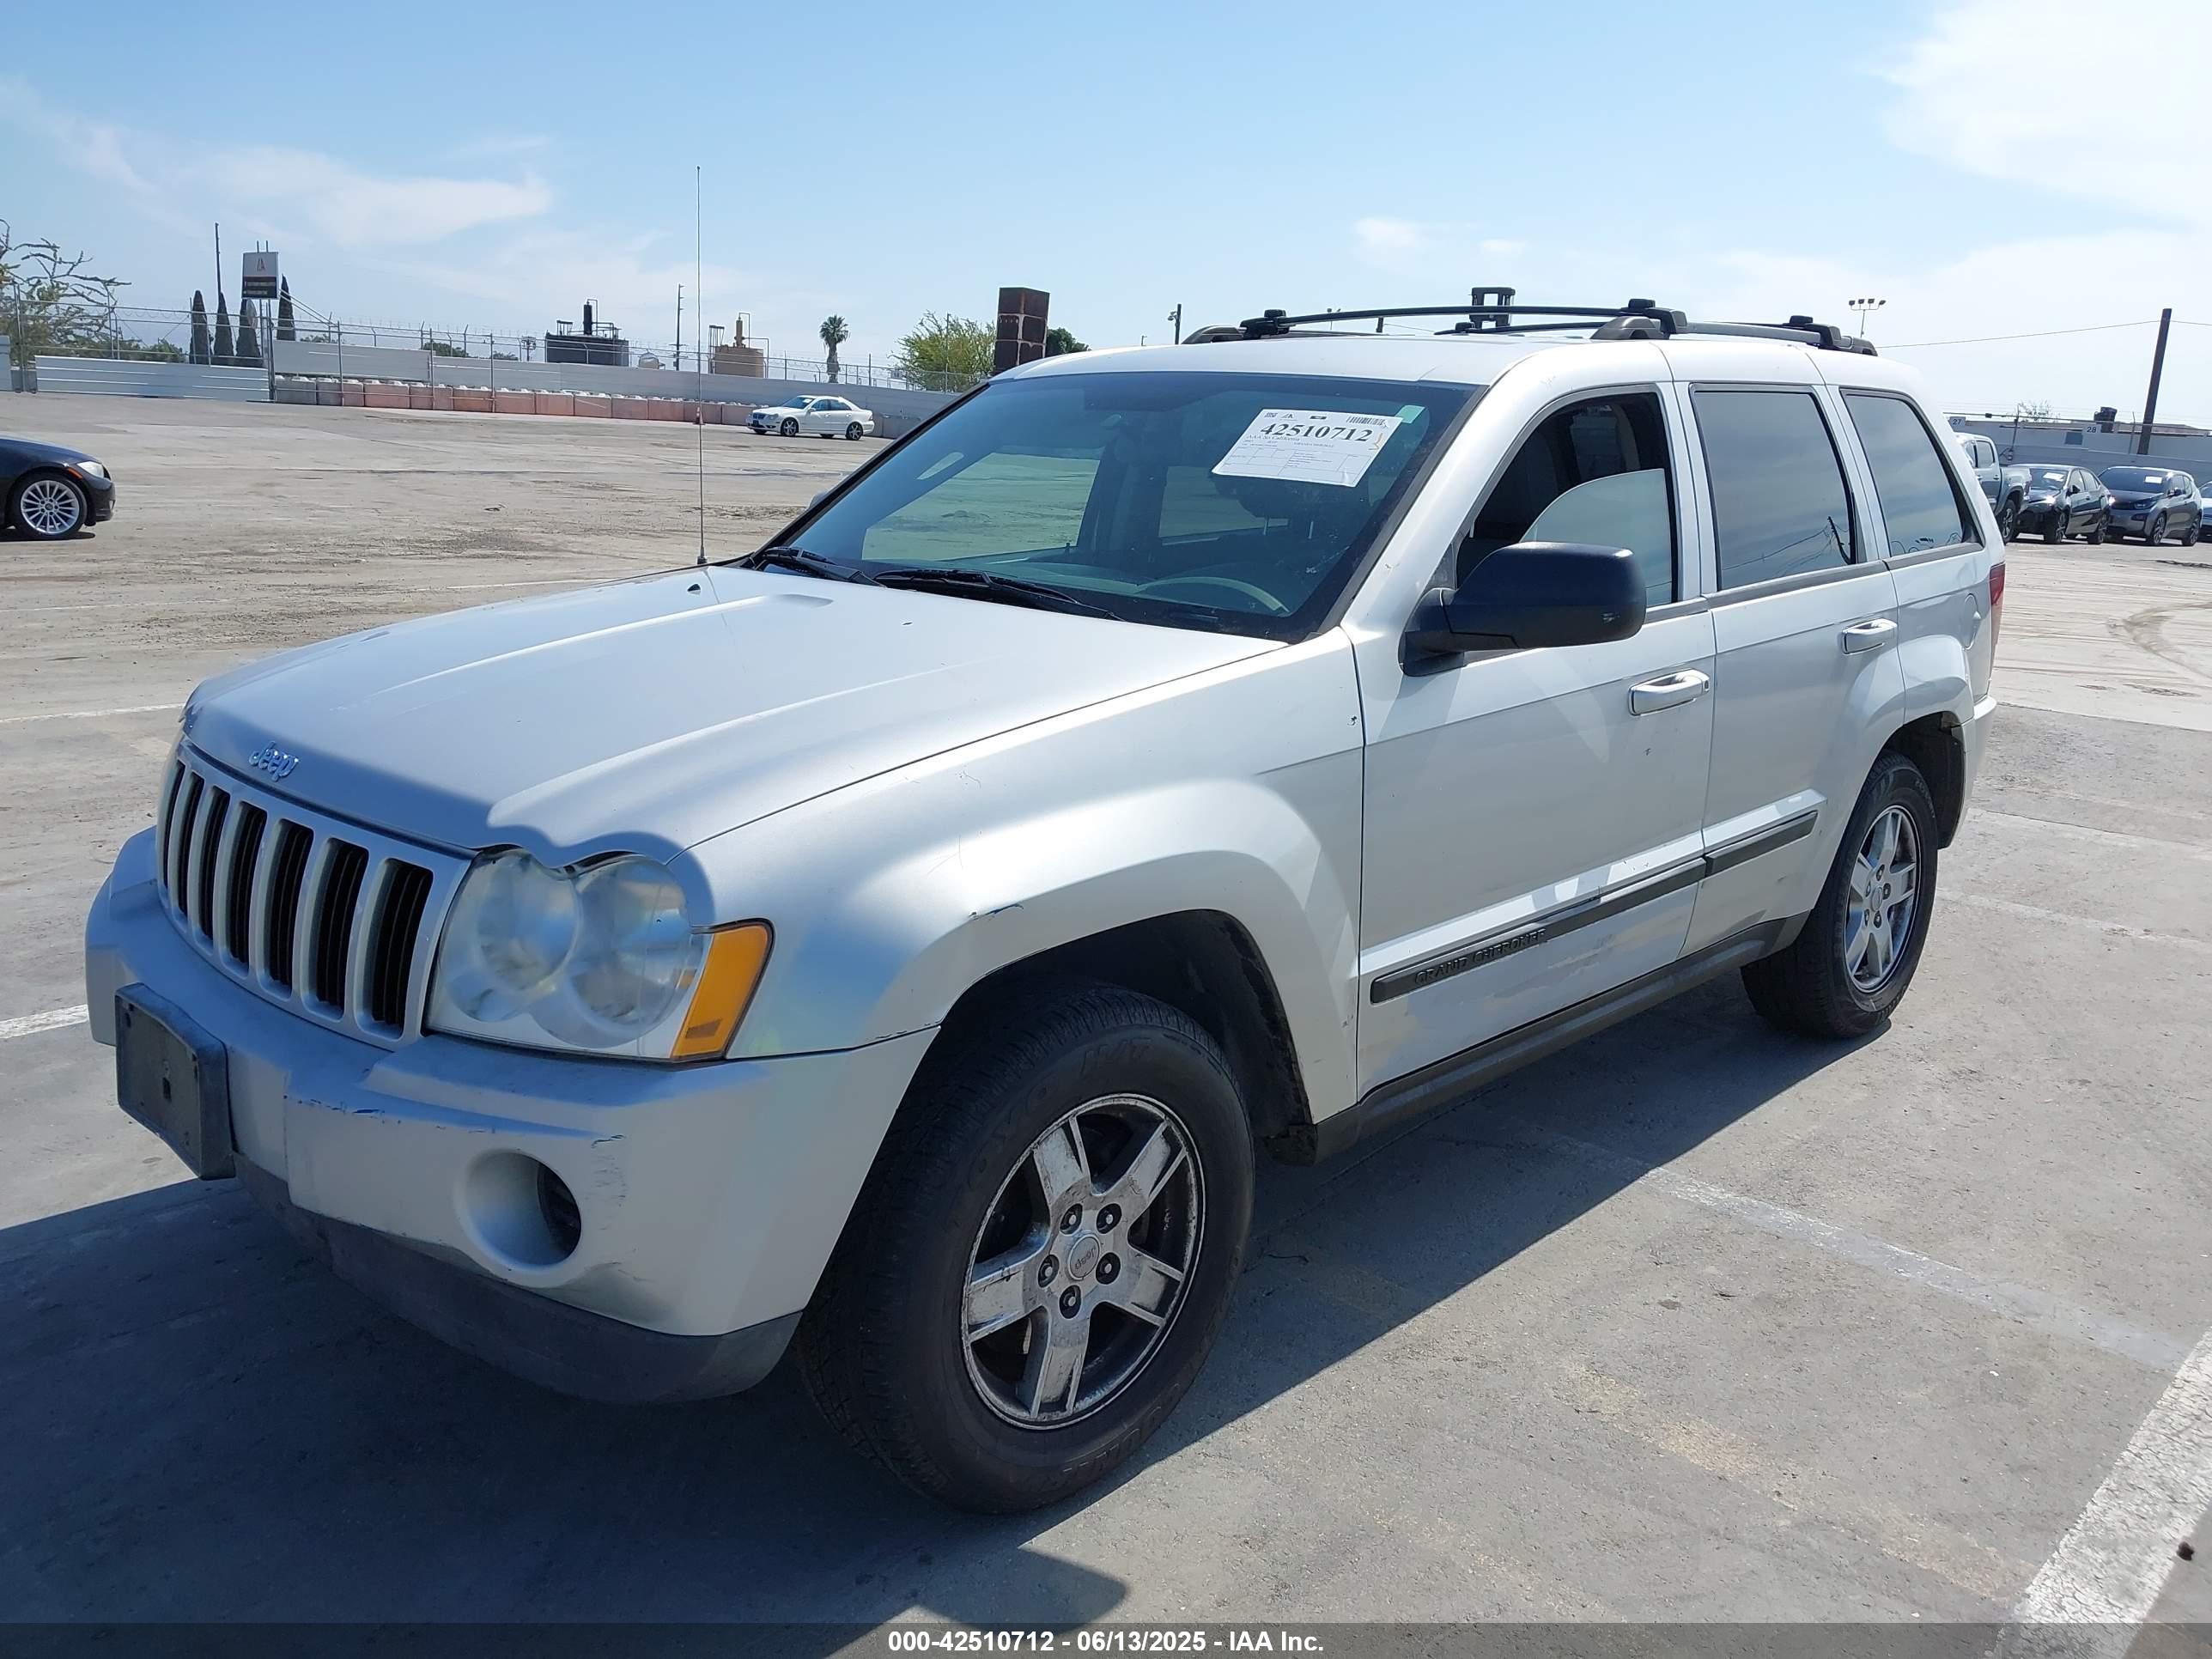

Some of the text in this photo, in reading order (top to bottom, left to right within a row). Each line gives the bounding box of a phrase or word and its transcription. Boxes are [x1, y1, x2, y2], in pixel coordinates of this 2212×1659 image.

[1260, 423, 1373, 442] 42510712
[248, 740, 299, 783] Jeep
[1415, 928, 1547, 987] GRAND CHEROKEE
[1075, 1245, 1097, 1270] Jeep
